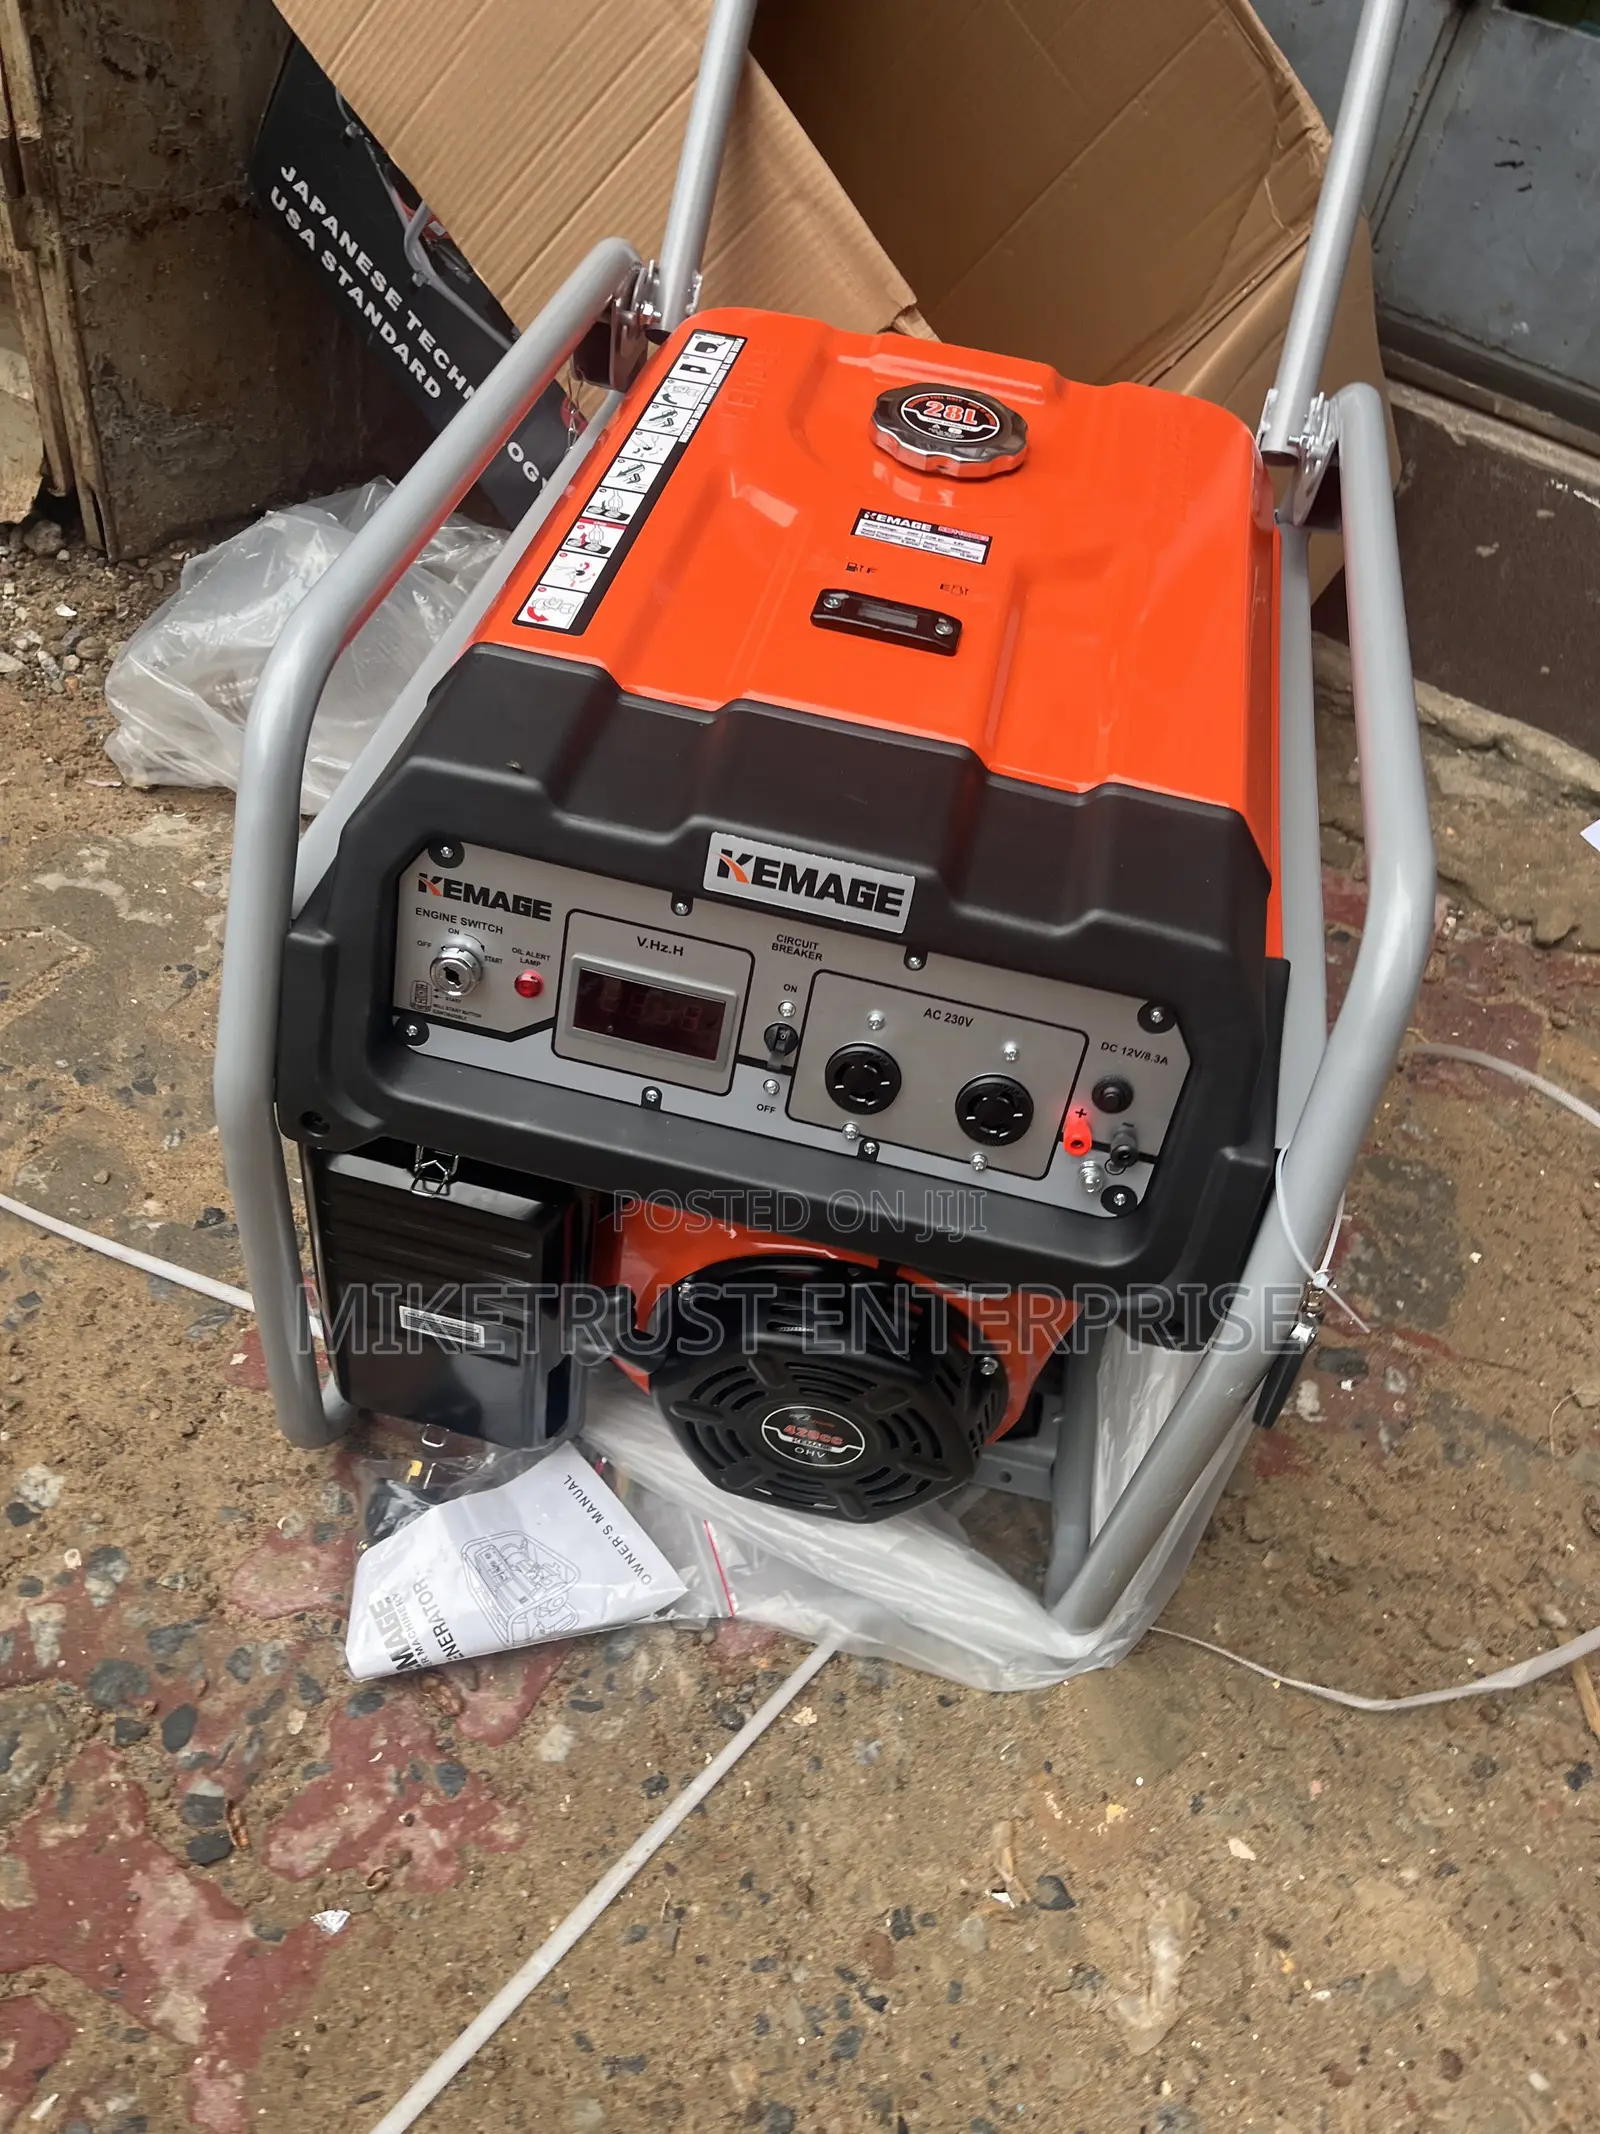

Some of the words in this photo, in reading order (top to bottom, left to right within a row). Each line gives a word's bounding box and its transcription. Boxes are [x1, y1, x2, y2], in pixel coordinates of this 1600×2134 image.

[280, 165, 404, 312] JAPANESE
[270, 185, 316, 251] USA
[320, 249, 442, 399] STANDARD
[922, 400, 978, 426] 28L
[864, 511, 932, 532] KEMAGE
[713, 848, 905, 917] KEMAGE
[416, 872, 552, 922] KEMAGE
[415, 906, 458, 924] ENGINE
[460, 916, 504, 935] SWITCH
[447, 927, 460, 936] ON
[416, 939, 432, 949] OFF
[636, 935, 684, 957] V.Hz.H
[771, 942, 823, 962] BREAKER
[776, 934, 819, 951] CIRCUIT
[484, 954, 503, 964] START
[511, 946, 524, 956] OIL
[525, 951, 551, 962] ALERT
[519, 957, 542, 967] LAMP
[783, 983, 798, 993] ON
[923, 1007, 941, 1021] AC
[943, 1011, 974, 1028] 230V
[1100, 1041, 1118, 1053] DC
[1121, 1046, 1169, 1066] 12V/8.3A
[756, 1103, 776, 1115] OFF
[794, 1446, 826, 1459] OHV
[563, 1473, 605, 1525] MANUAL
[602, 1523, 653, 1586] OWNER'S
